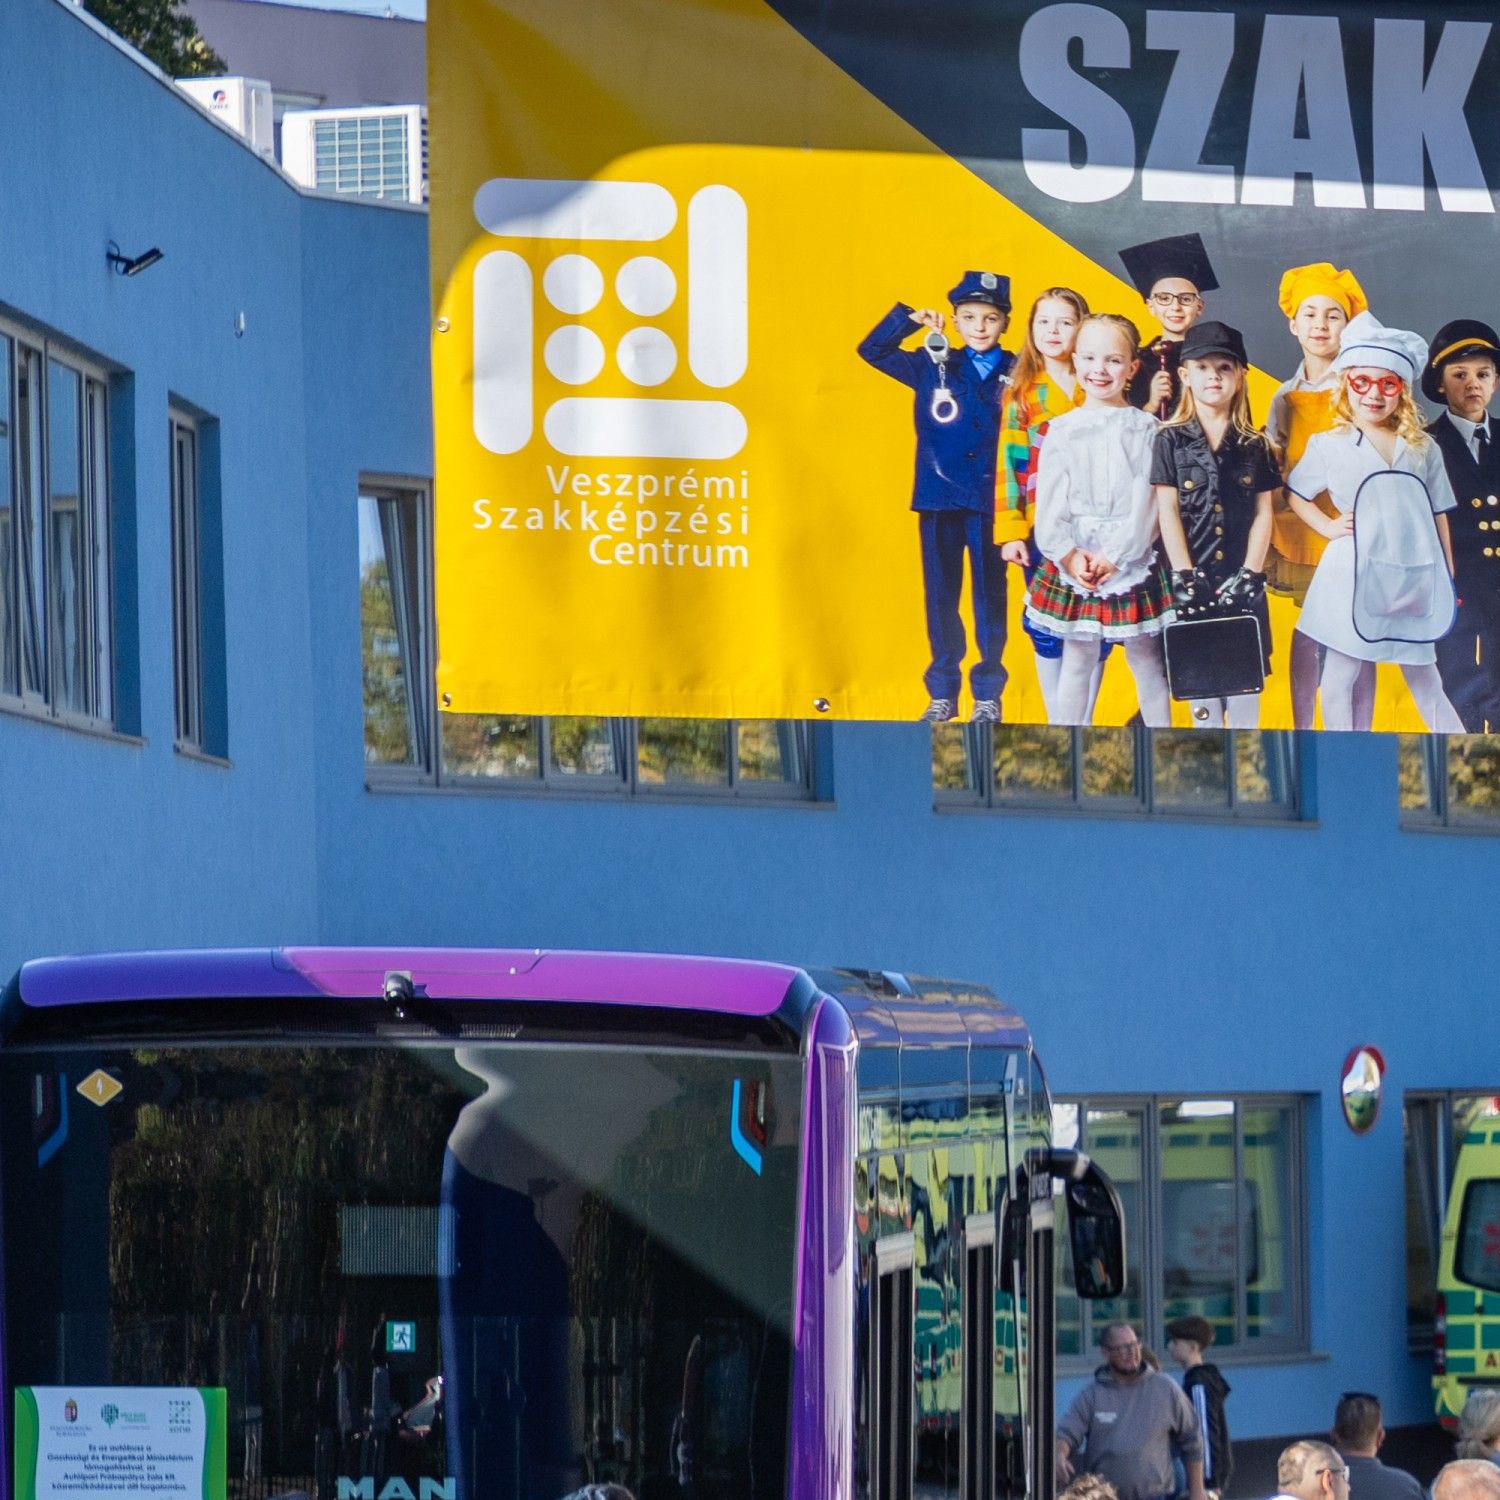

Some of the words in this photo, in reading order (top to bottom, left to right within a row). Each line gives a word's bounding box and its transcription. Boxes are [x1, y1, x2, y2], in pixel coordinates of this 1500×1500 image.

[545, 463, 749, 504] Veszprémi
[472, 498, 749, 540] Szakképzési
[588, 533, 749, 568] Centrum
